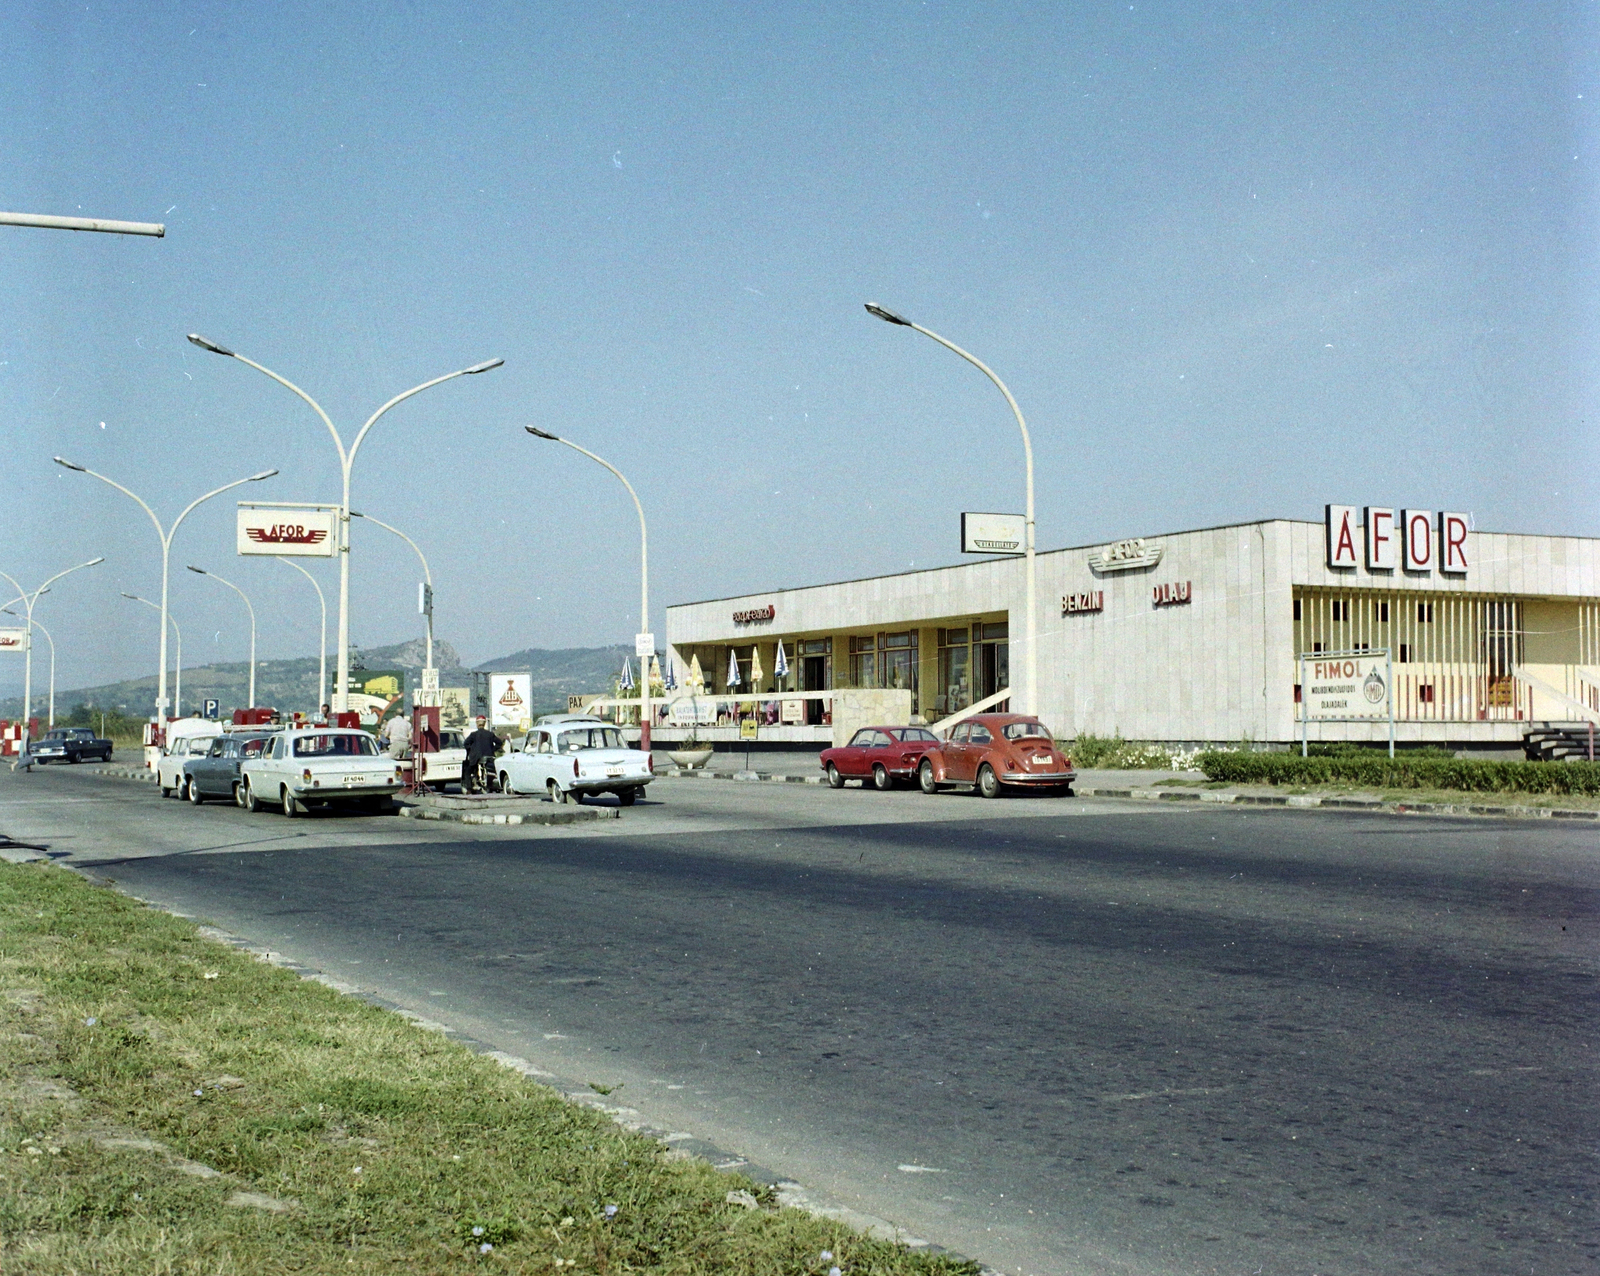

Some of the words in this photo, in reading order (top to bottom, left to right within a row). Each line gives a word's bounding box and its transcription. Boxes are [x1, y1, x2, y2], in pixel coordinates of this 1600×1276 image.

[269, 524, 305, 540] ÁFOR
[1335, 510, 1468, 568] ÁFOR
[1061, 590, 1103, 613] BENZIN
[1152, 581, 1191, 605] OLAJ
[1314, 661, 1363, 680] FIMOL
[207, 700, 216, 715] P
[569, 696, 583, 709] PAX
